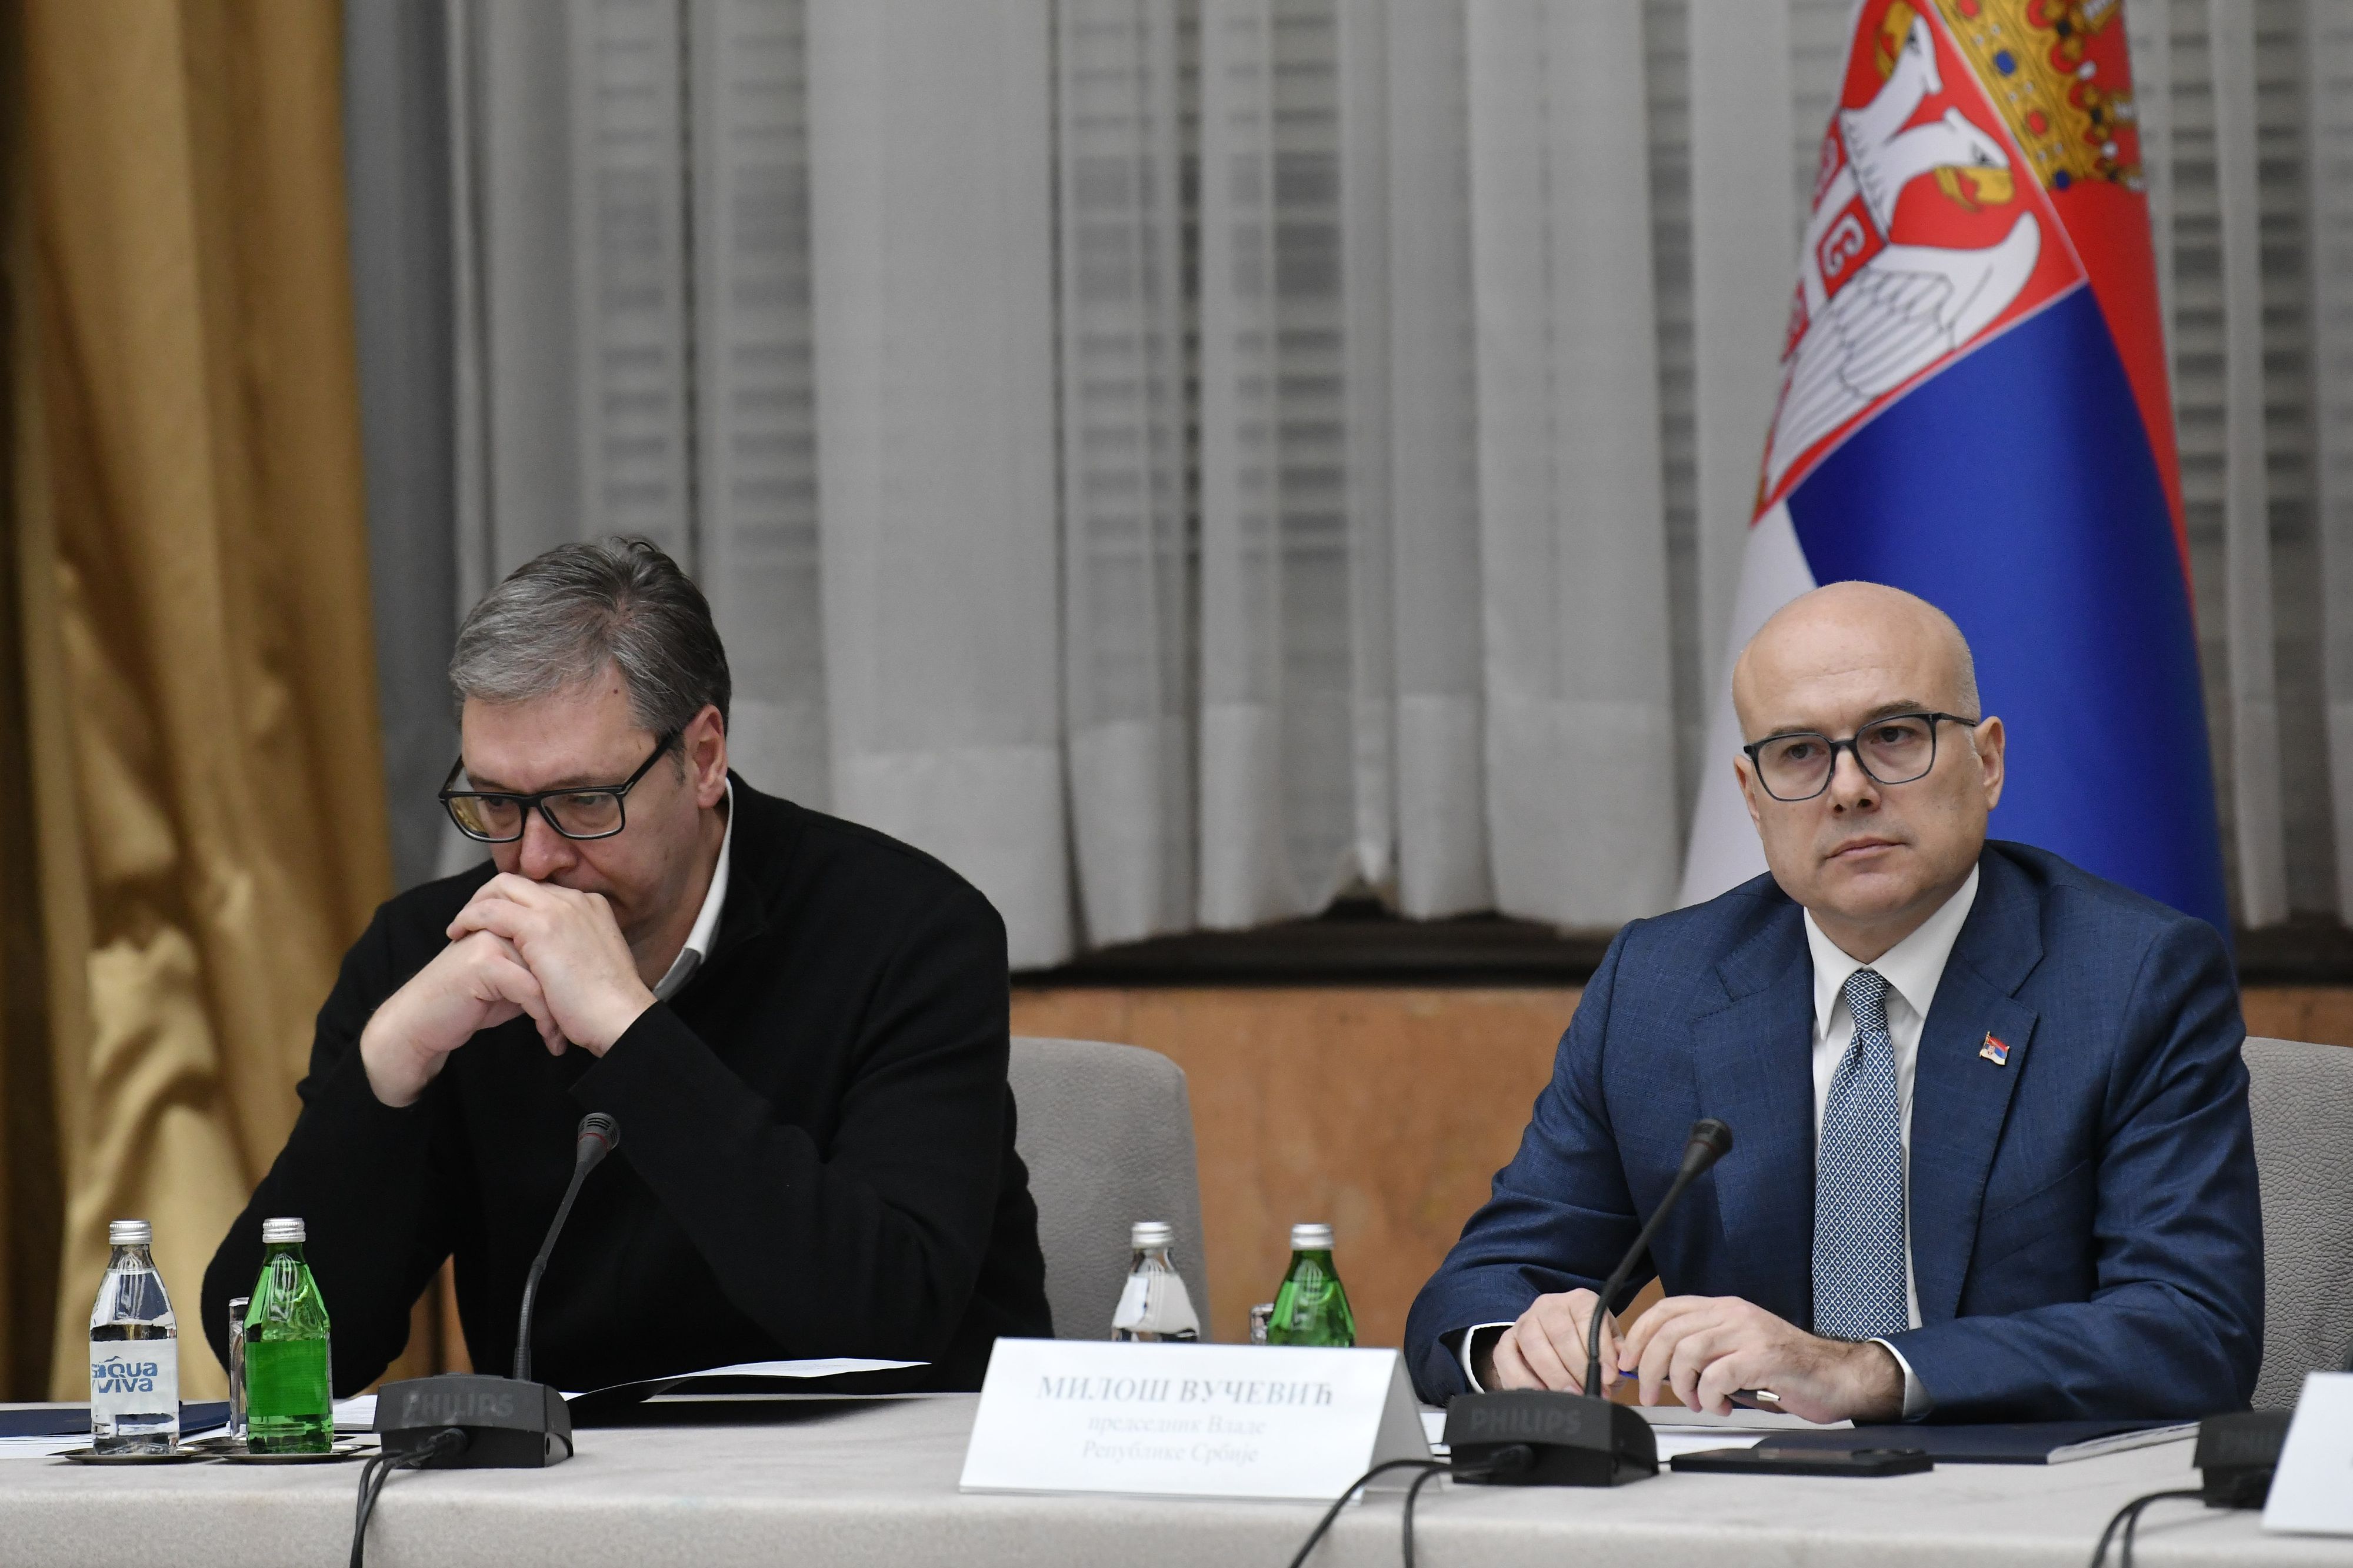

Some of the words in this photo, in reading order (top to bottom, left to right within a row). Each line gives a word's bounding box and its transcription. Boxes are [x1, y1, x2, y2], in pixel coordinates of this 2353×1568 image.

[1036, 1376, 1169, 1402] МИЛОШ
[1179, 1379, 1333, 1405] ВУЧЕВИЋ
[403, 1392, 514, 1417] PHILIPS
[1088, 1416, 1202, 1435] председник
[1208, 1414, 1267, 1435] Владе
[1471, 1407, 1582, 1434] PHILIPS
[1082, 1440, 1186, 1463] Републике
[1191, 1443, 1259, 1466] Србије
